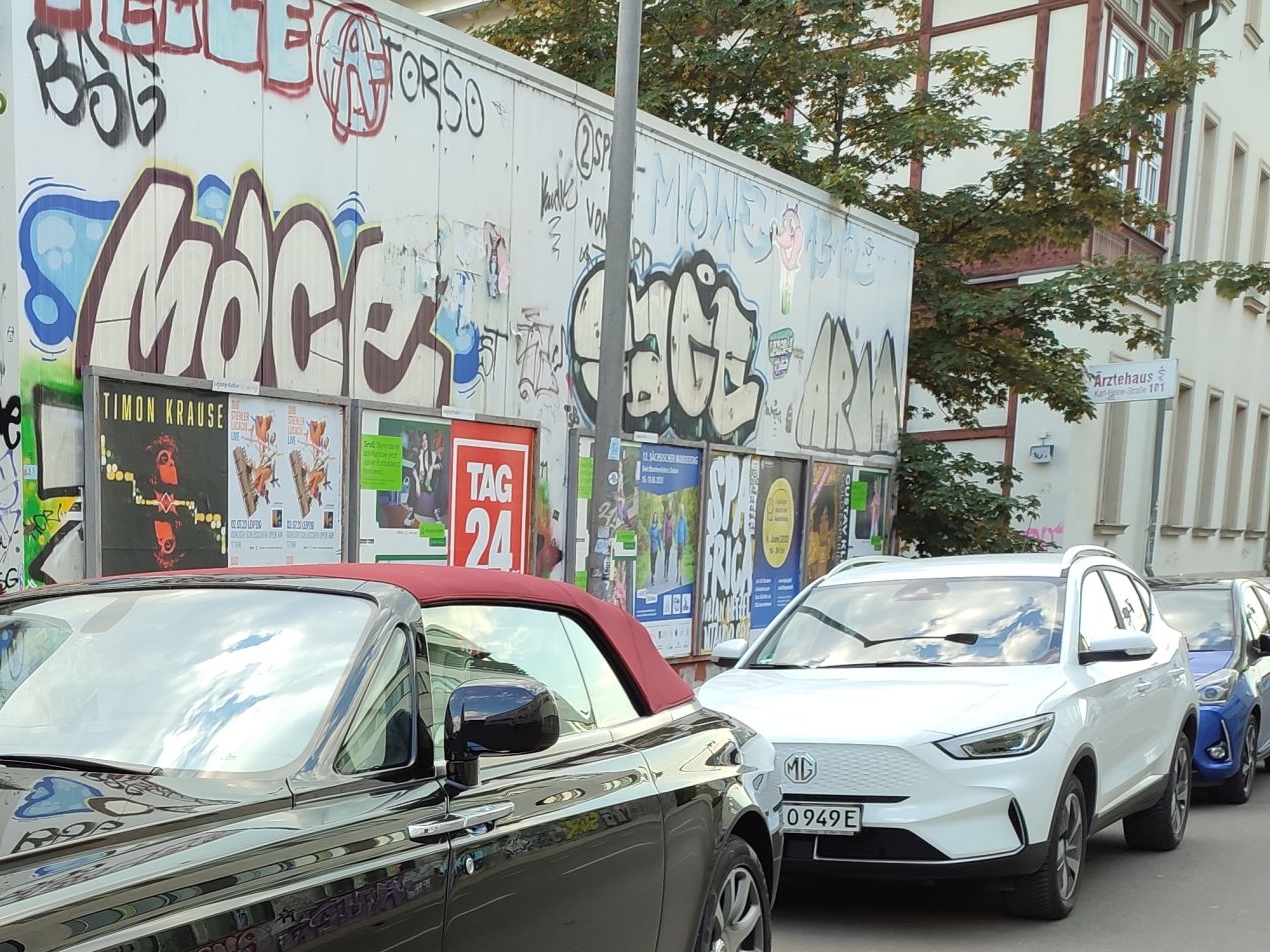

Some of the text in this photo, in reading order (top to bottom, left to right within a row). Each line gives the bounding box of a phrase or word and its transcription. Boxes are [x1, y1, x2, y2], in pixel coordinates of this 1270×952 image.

[1094, 371, 1154, 388] Ärztehaus
[1149, 382, 1165, 393] 101
[103, 392, 224, 429] TIMON KRAUSE
[466, 461, 513, 503] TAG
[465, 507, 514, 573] 24
[787, 758, 813, 780] MG
